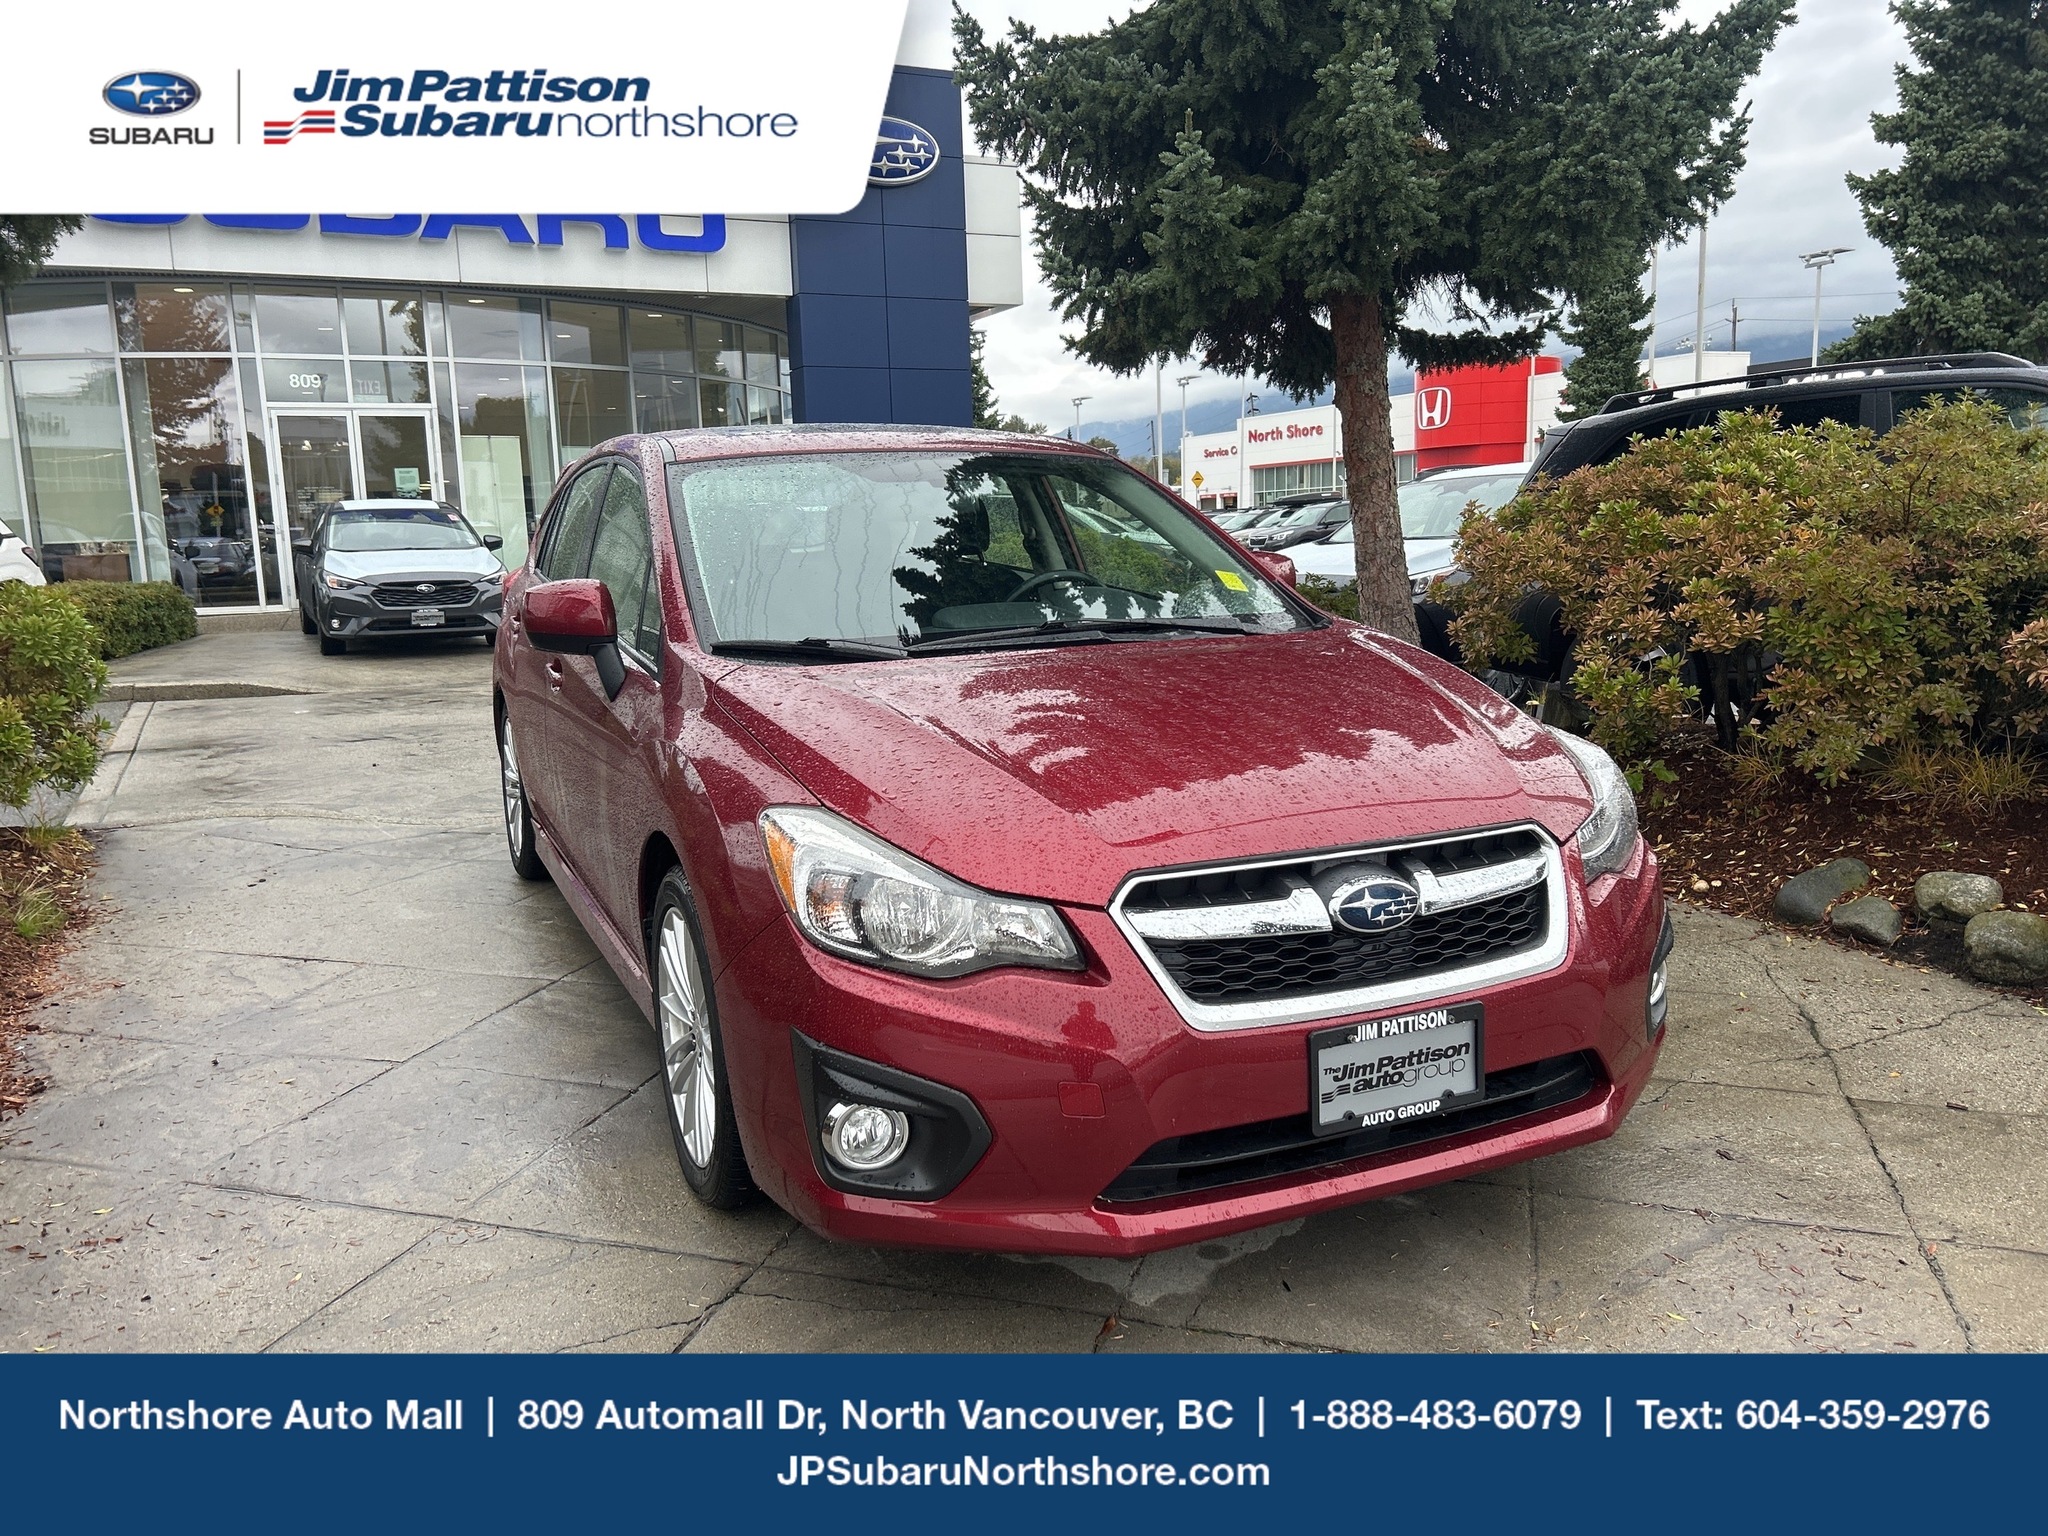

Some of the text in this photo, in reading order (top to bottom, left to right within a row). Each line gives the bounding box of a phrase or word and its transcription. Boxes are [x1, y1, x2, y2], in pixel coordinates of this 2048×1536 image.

[288, 373, 322, 388] 809
[1248, 424, 1324, 443] North Shore
[1204, 447, 1229, 458] Service
[1355, 1009, 1448, 1042] JIM PATTISON
[1323, 1042, 1471, 1082] The Jim Pattison
[1361, 1100, 1441, 1127] AUTO GROUP
